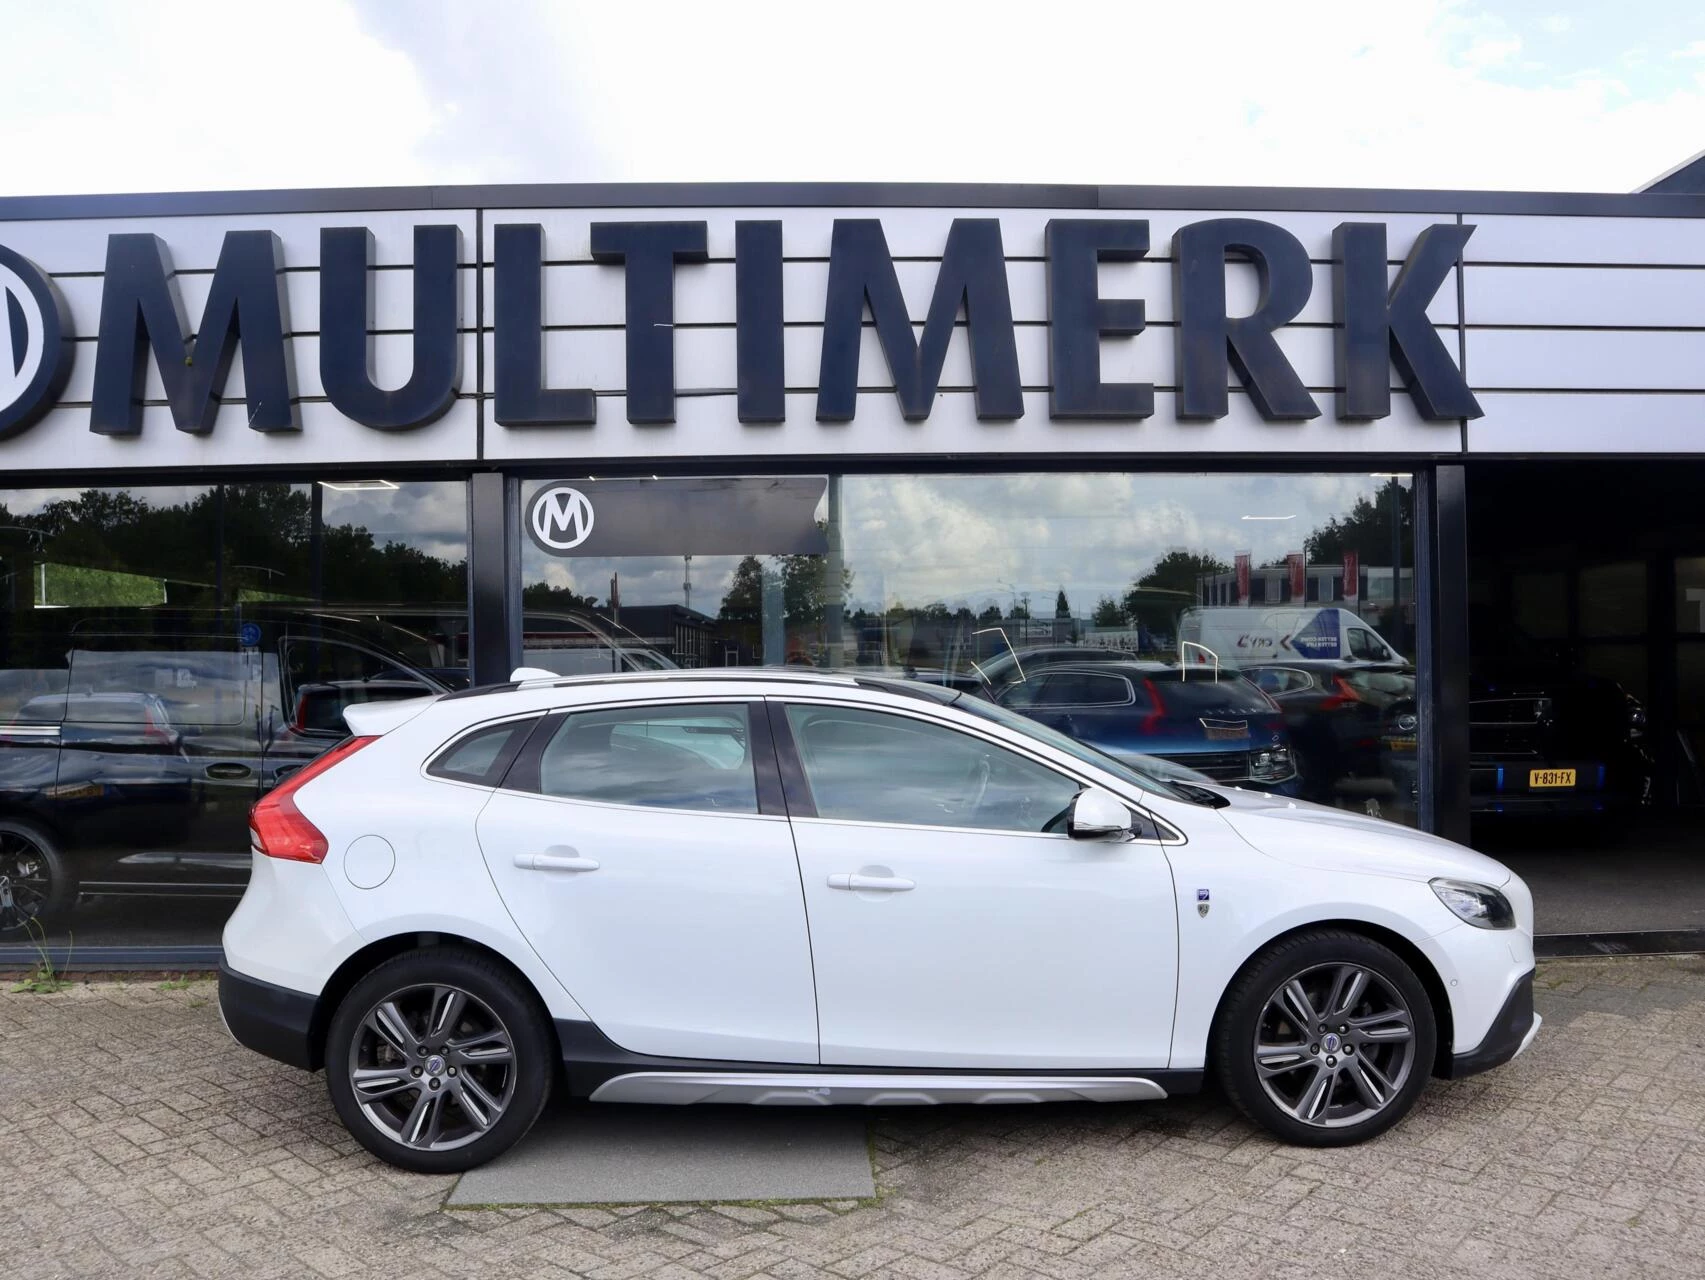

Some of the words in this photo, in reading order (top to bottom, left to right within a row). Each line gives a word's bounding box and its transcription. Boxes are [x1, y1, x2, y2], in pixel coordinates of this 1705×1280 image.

[89, 217, 1485, 436] MULTIMERK
[539, 490, 587, 545] M
[1534, 771, 1572, 785] V-831-FX
